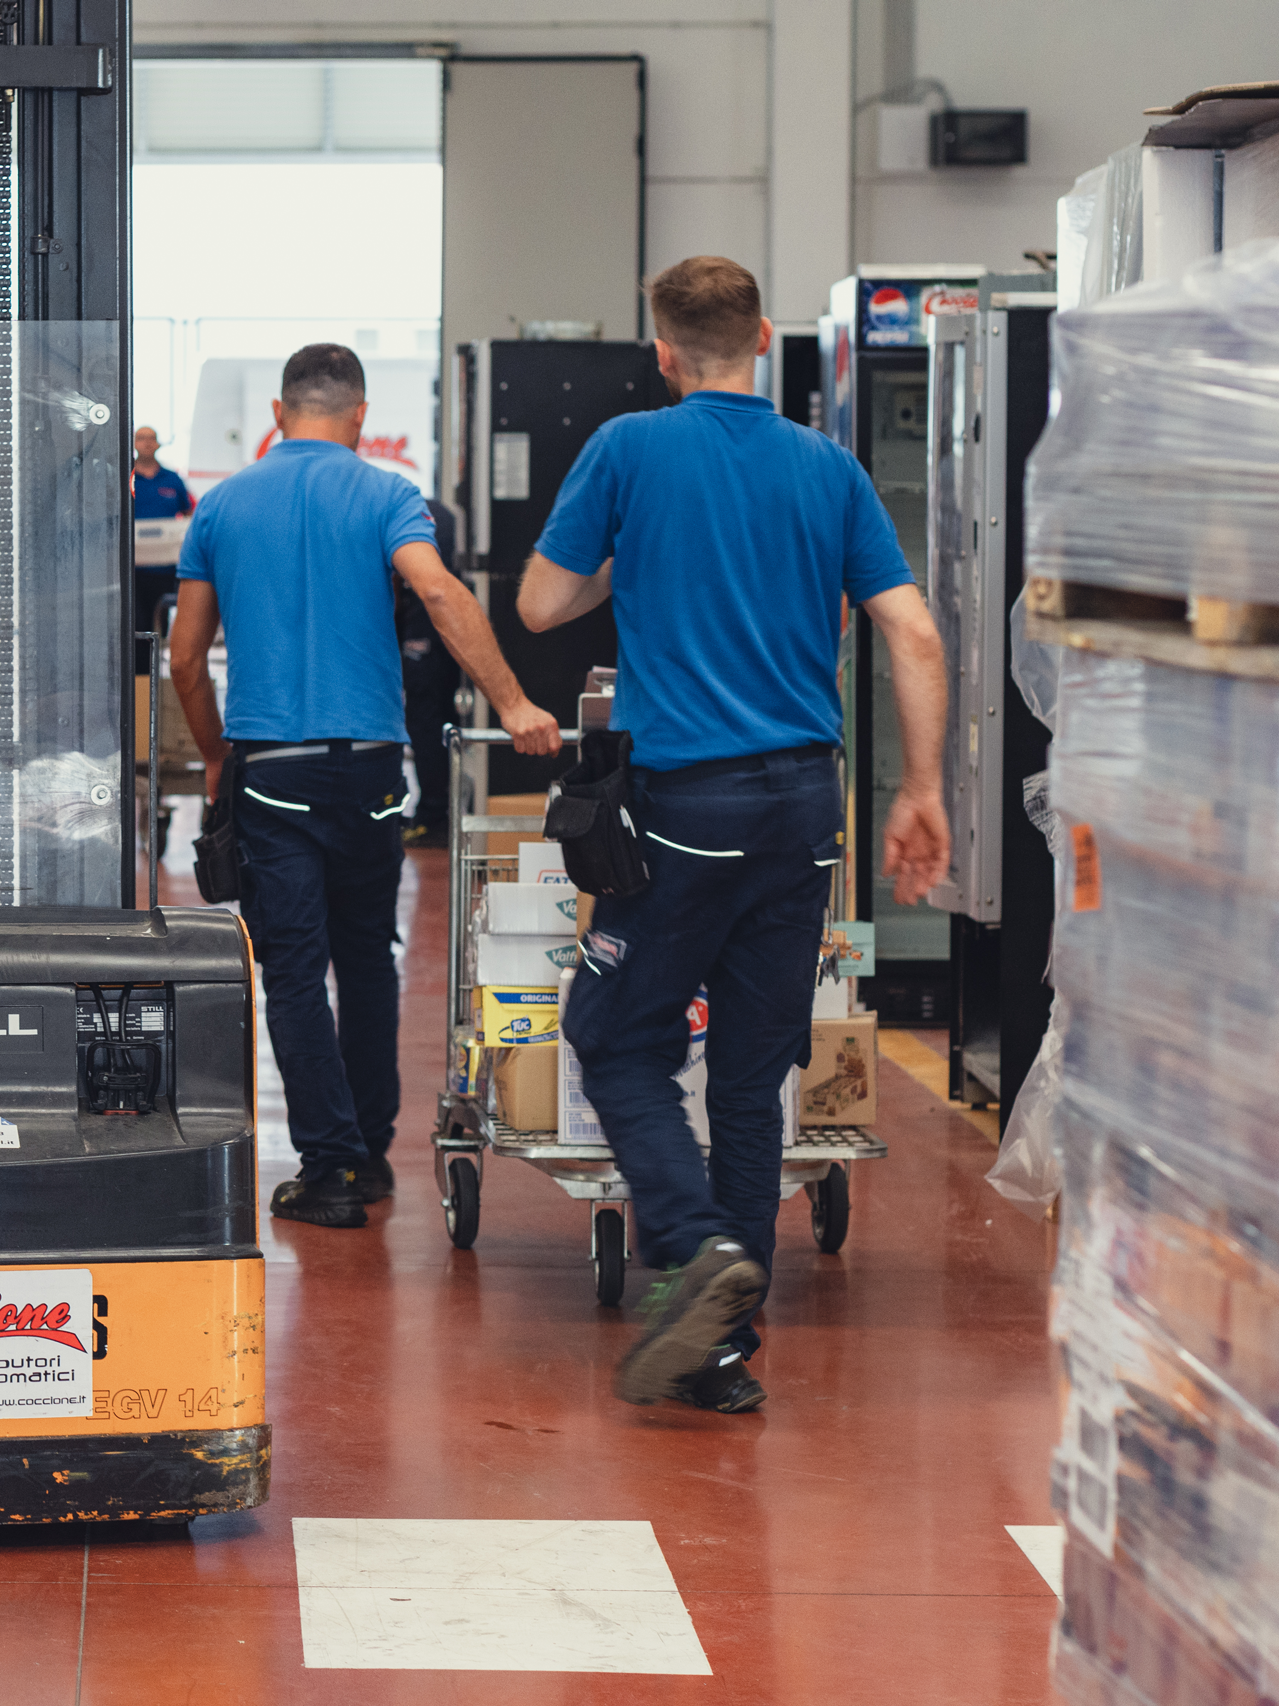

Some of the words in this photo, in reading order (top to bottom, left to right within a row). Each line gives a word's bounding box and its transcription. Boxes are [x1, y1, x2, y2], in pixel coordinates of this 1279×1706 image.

[520, 994, 558, 1003] ORIGINA
[86, 1388, 168, 1420] EGV
[178, 1387, 220, 1417] 14
